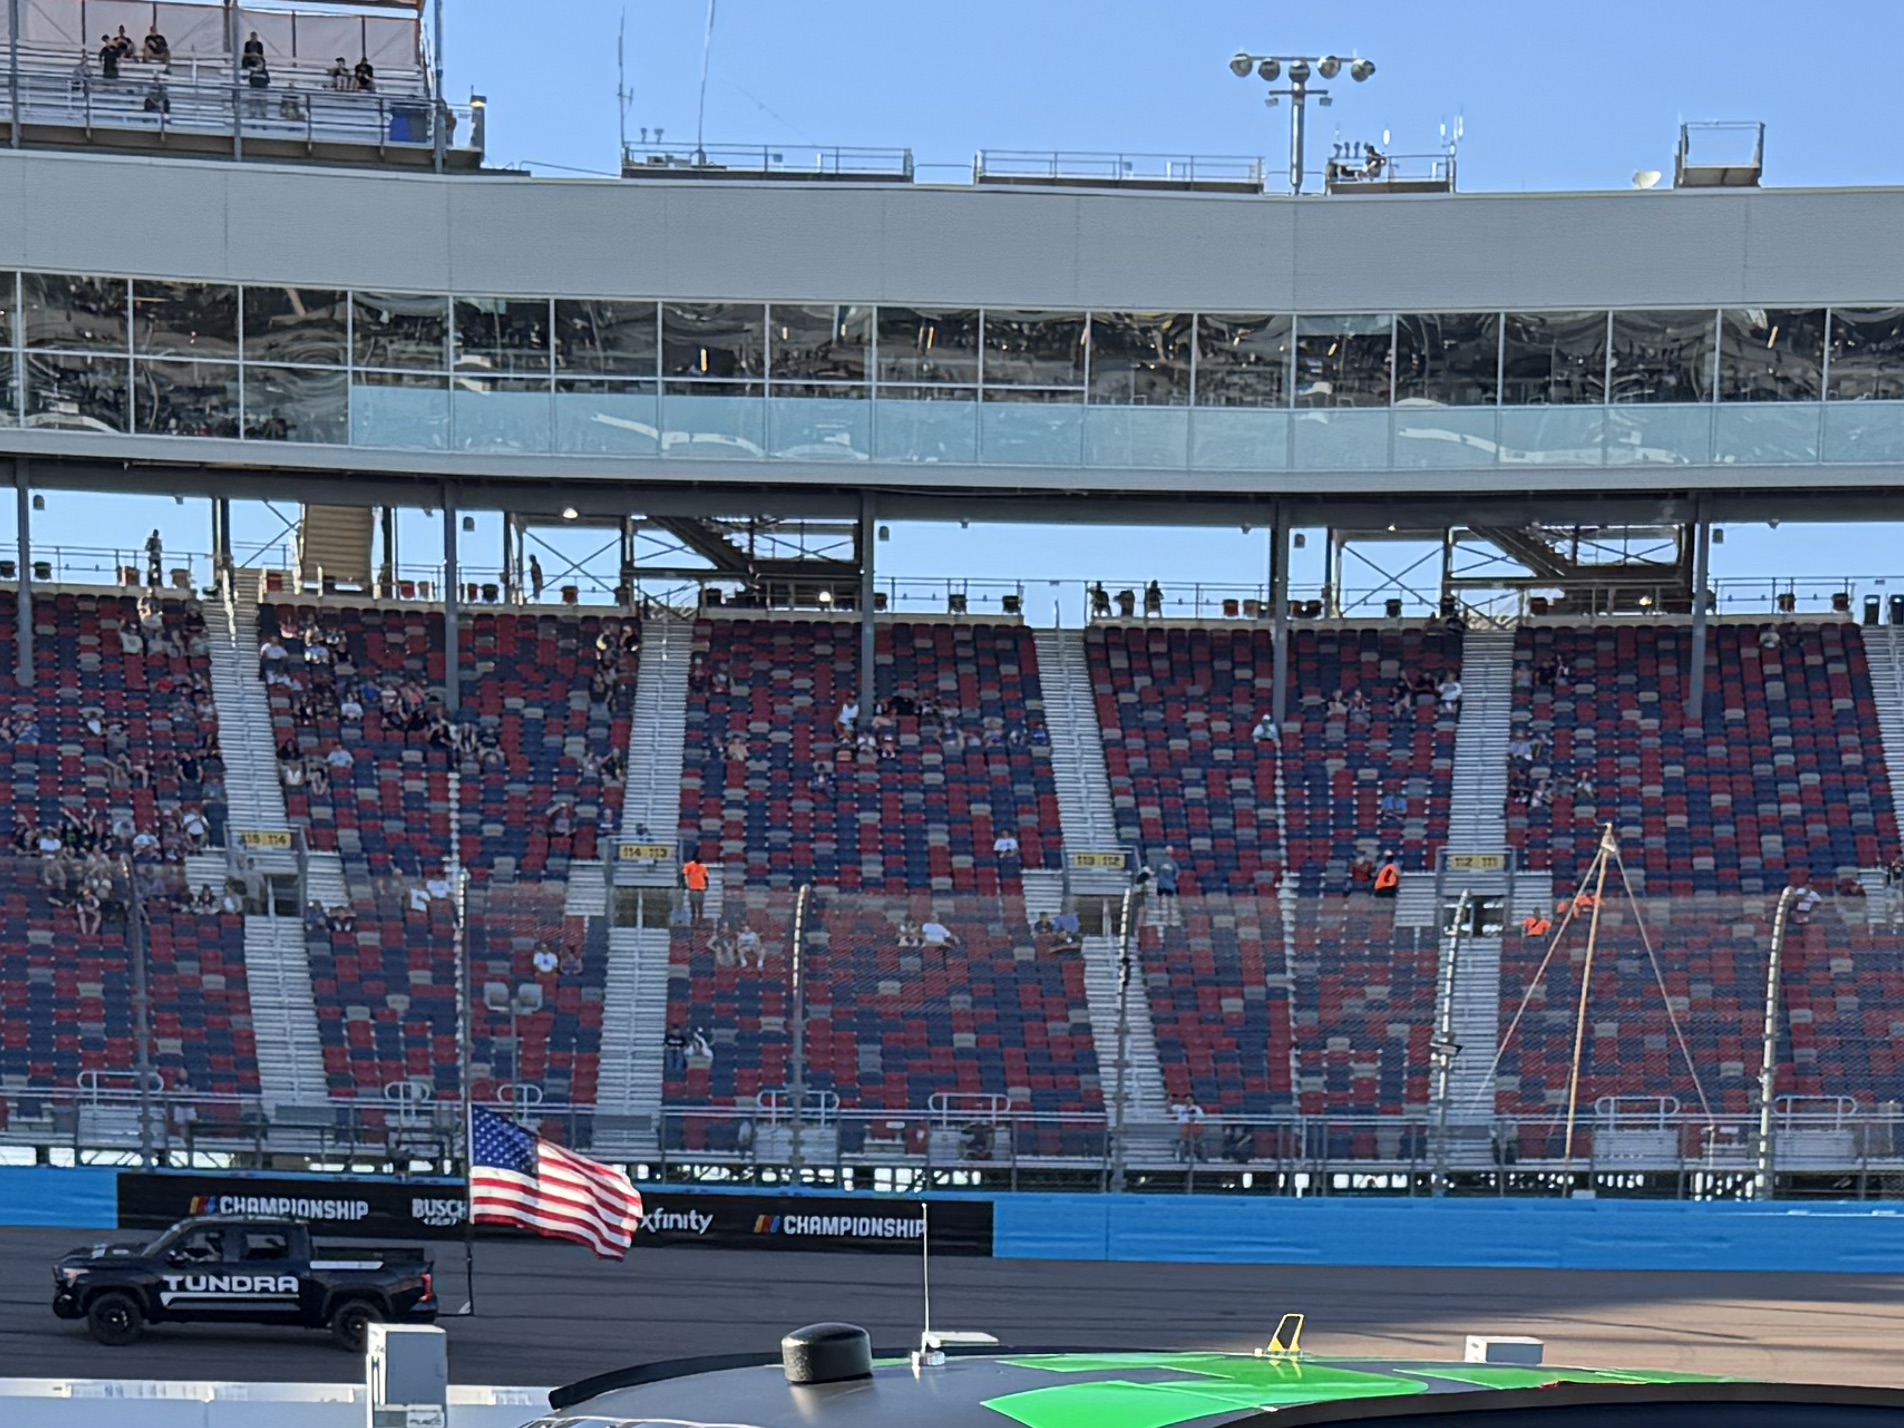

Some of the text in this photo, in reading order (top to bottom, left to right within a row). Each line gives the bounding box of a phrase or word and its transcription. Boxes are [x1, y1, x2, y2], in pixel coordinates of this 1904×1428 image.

[220, 1196, 369, 1221] CHAMPIONSHIP
[640, 1207, 714, 1235] xfinity
[783, 1215, 927, 1238] CHAMPIONSHIP
[162, 1275, 300, 1293] TUNDRA
